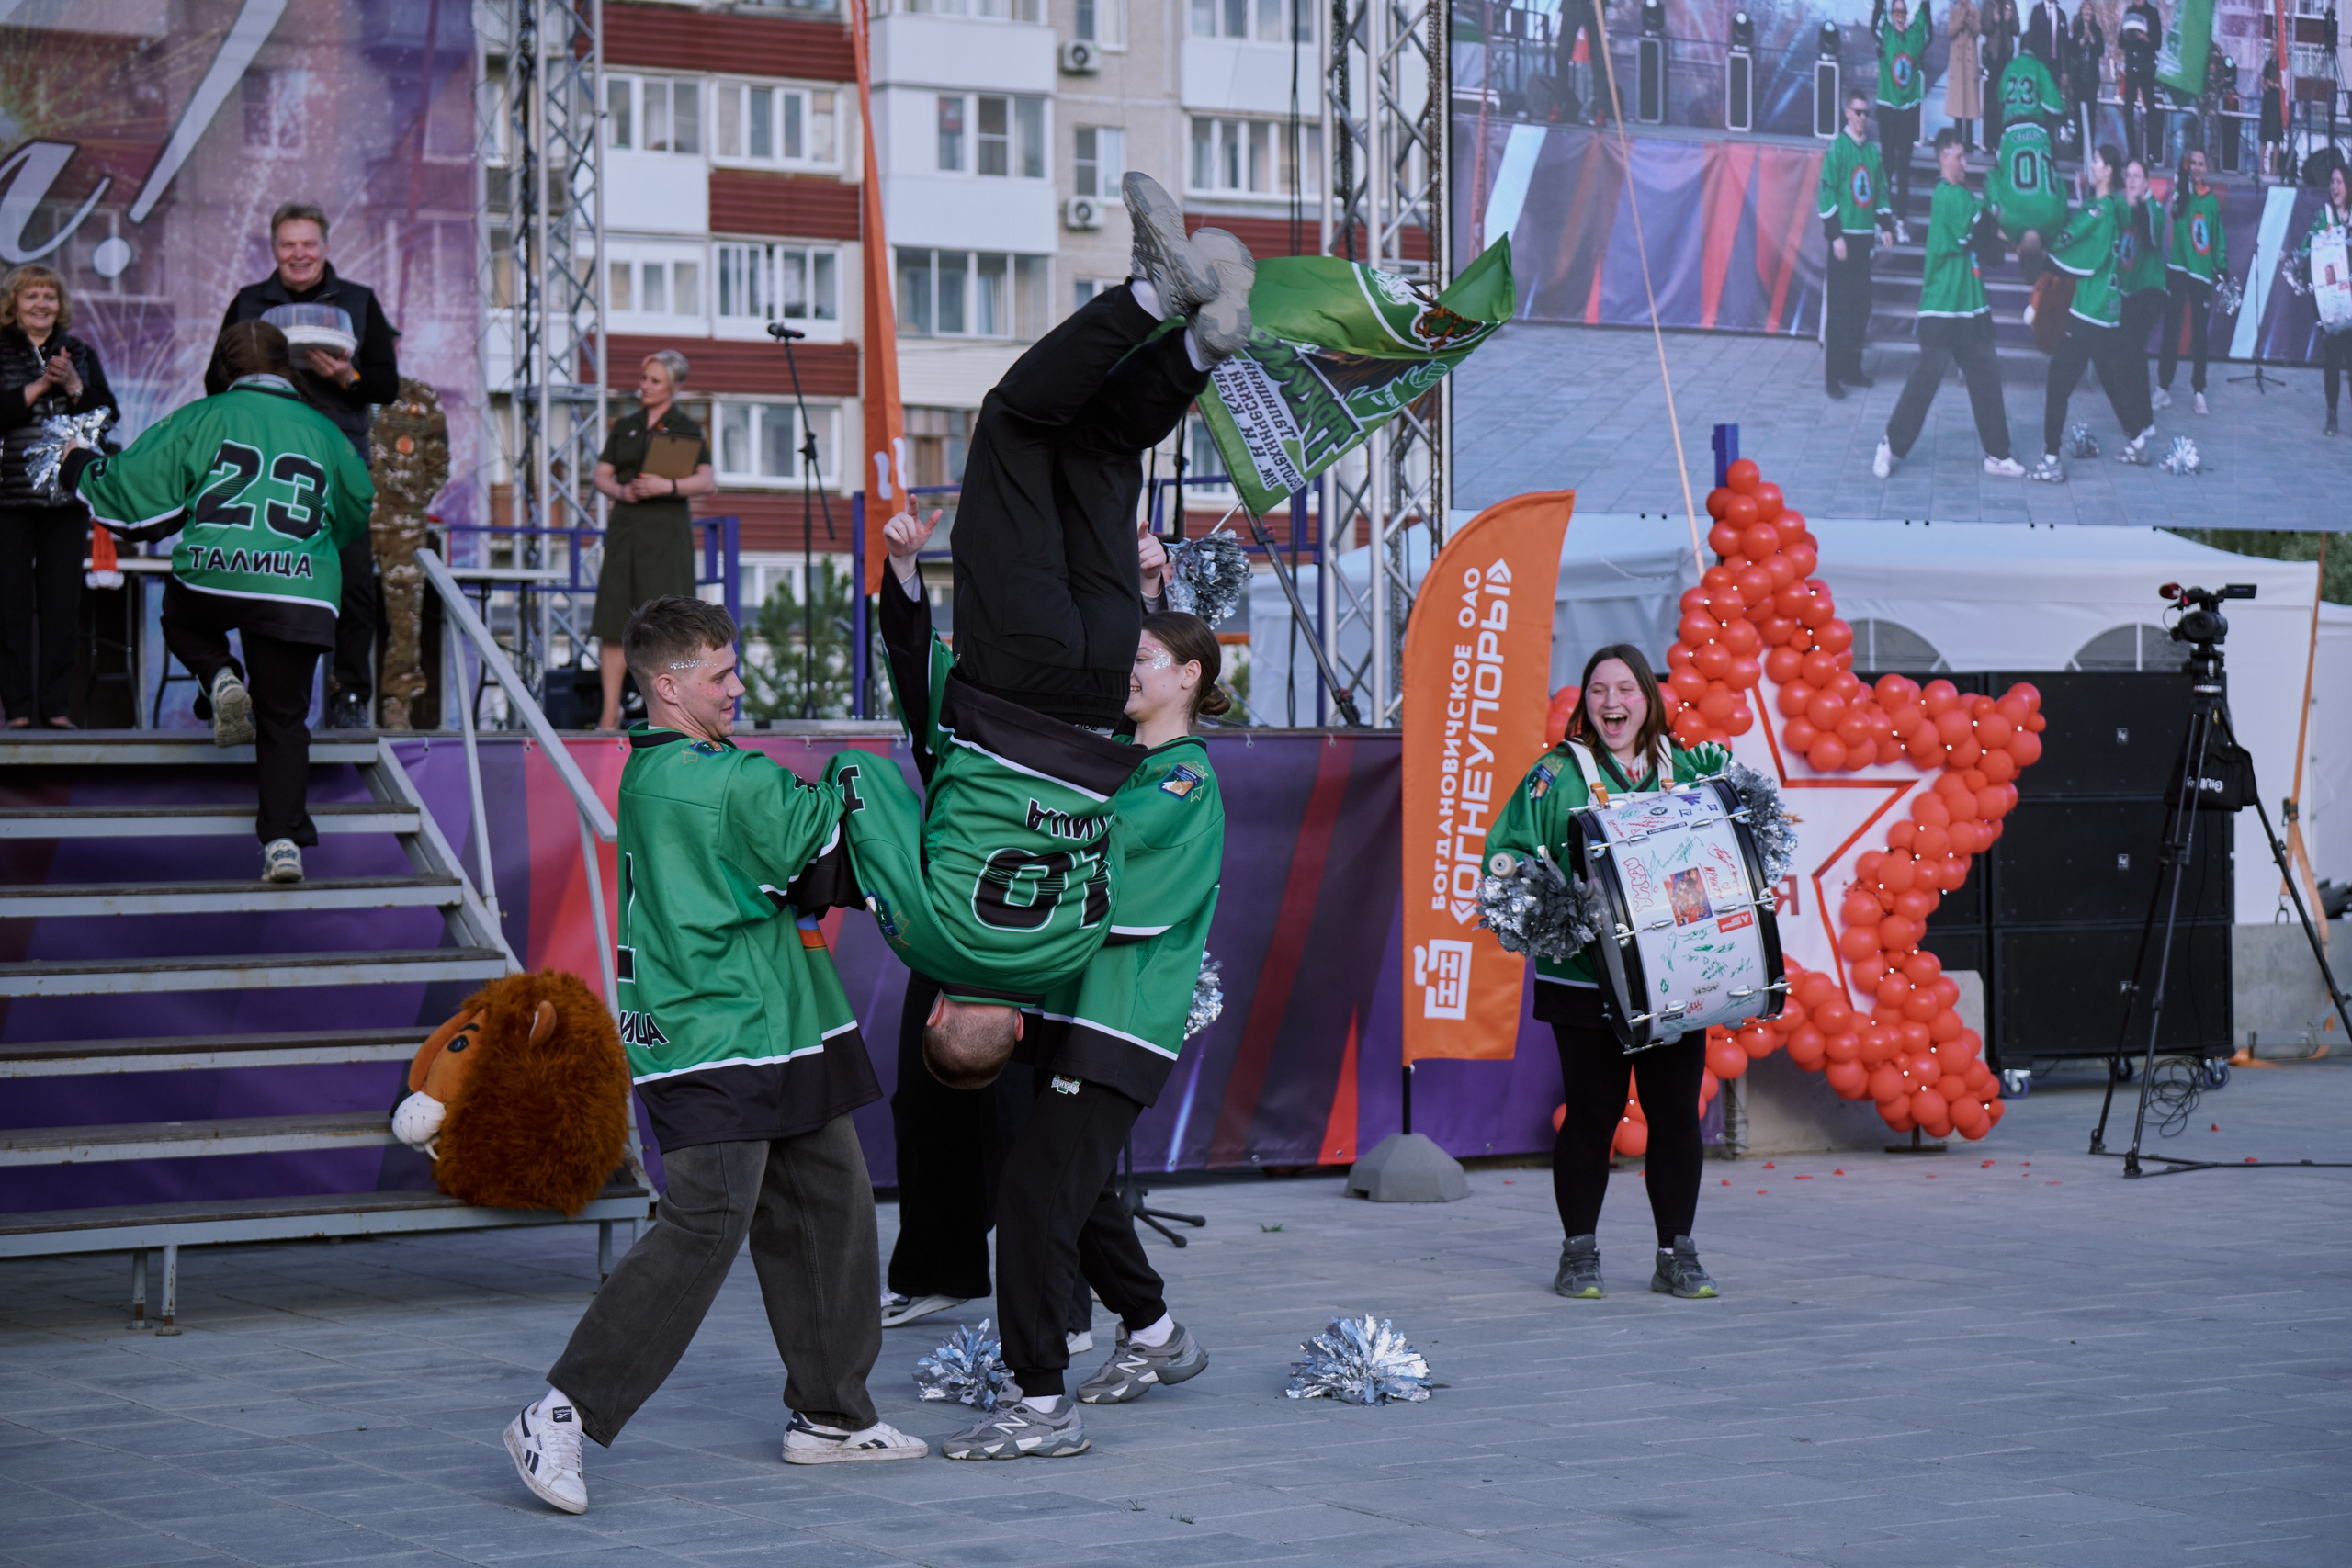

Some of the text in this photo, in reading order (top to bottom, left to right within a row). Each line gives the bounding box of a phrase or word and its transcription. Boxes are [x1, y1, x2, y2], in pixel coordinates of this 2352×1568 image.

[195, 439, 328, 542] 23
[188, 545, 313, 579] ТАЛИЦА
[1431, 566, 1481, 910] БОГДАНОВИЧСКОЕ ОАО
[619, 1010, 670, 1049] ИЦА
